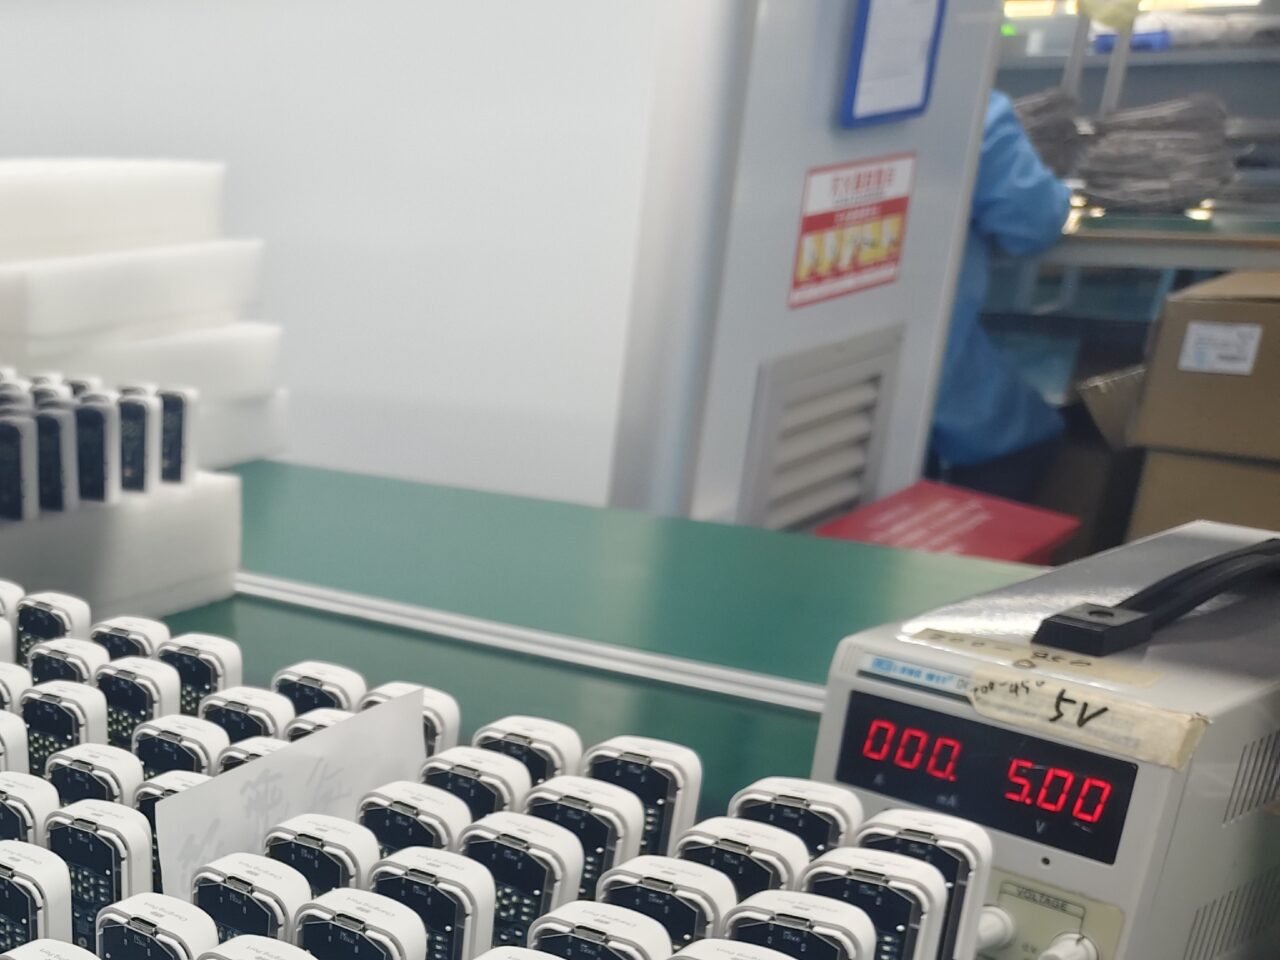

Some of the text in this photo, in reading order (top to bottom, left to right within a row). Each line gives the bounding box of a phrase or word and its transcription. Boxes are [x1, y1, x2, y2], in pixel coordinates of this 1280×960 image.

[1049, 689, 1109, 728] 5V
[1004, 758, 1112, 823] 5.00
[1035, 820, 1048, 835] V
[1017, 886, 1068, 912] VOLTAGE
